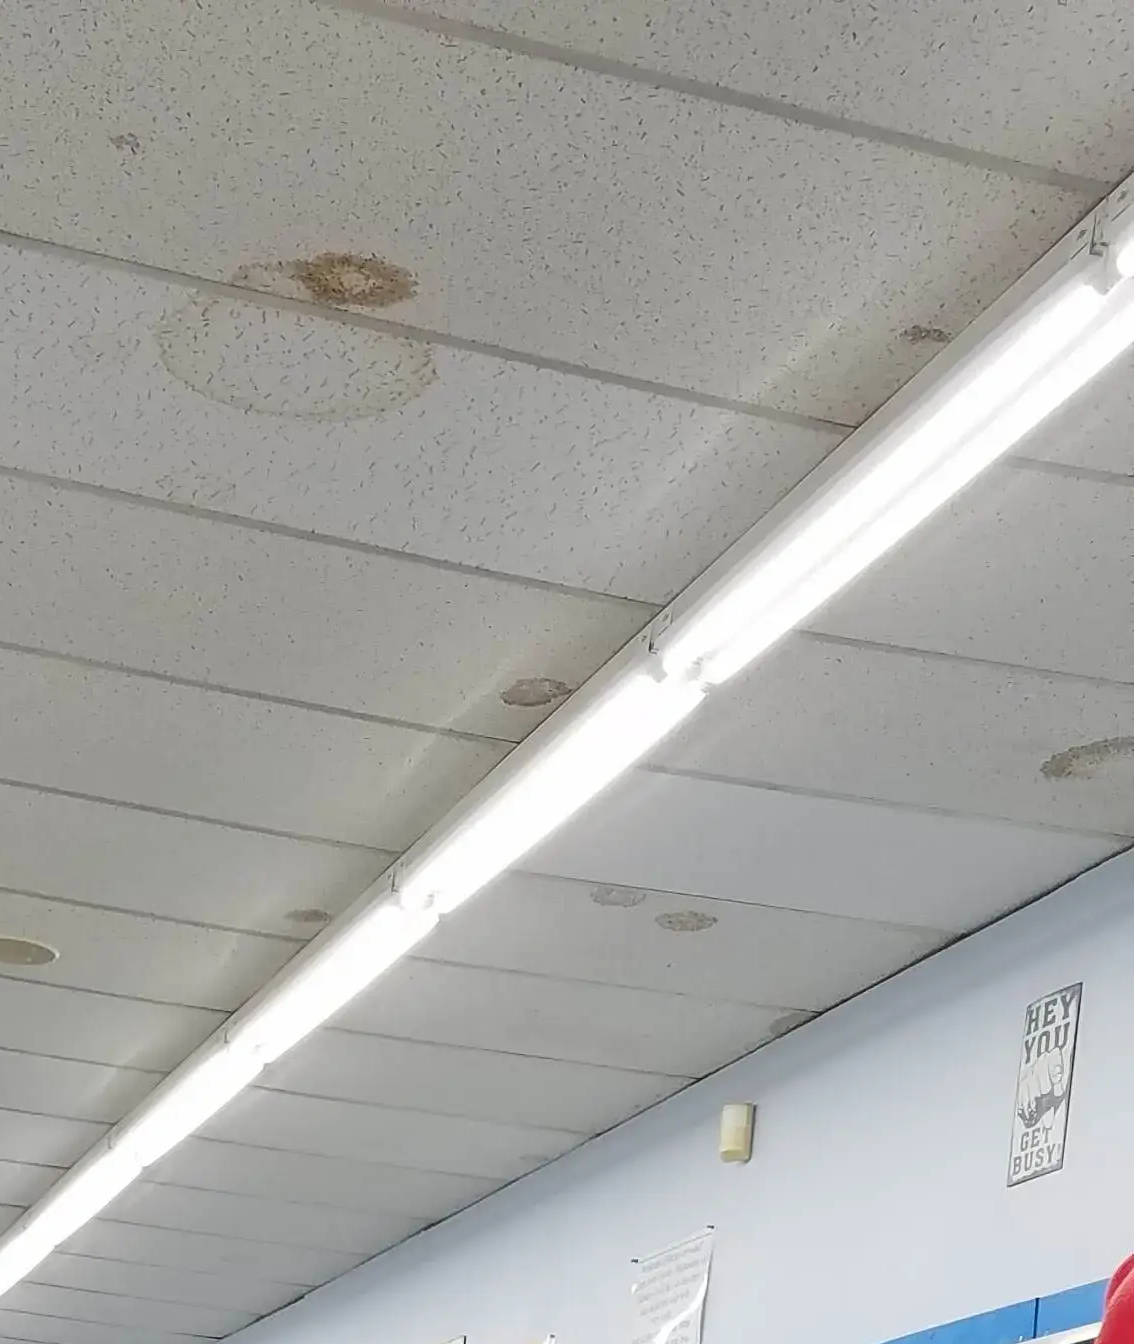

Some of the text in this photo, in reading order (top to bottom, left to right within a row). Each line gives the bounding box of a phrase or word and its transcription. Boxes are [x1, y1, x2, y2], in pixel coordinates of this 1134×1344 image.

[1026, 991, 1077, 1037] HEY
[1025, 1022, 1071, 1065] YOU
[1020, 1126, 1053, 1153] GET
[1013, 1142, 1062, 1178] BUSY!
